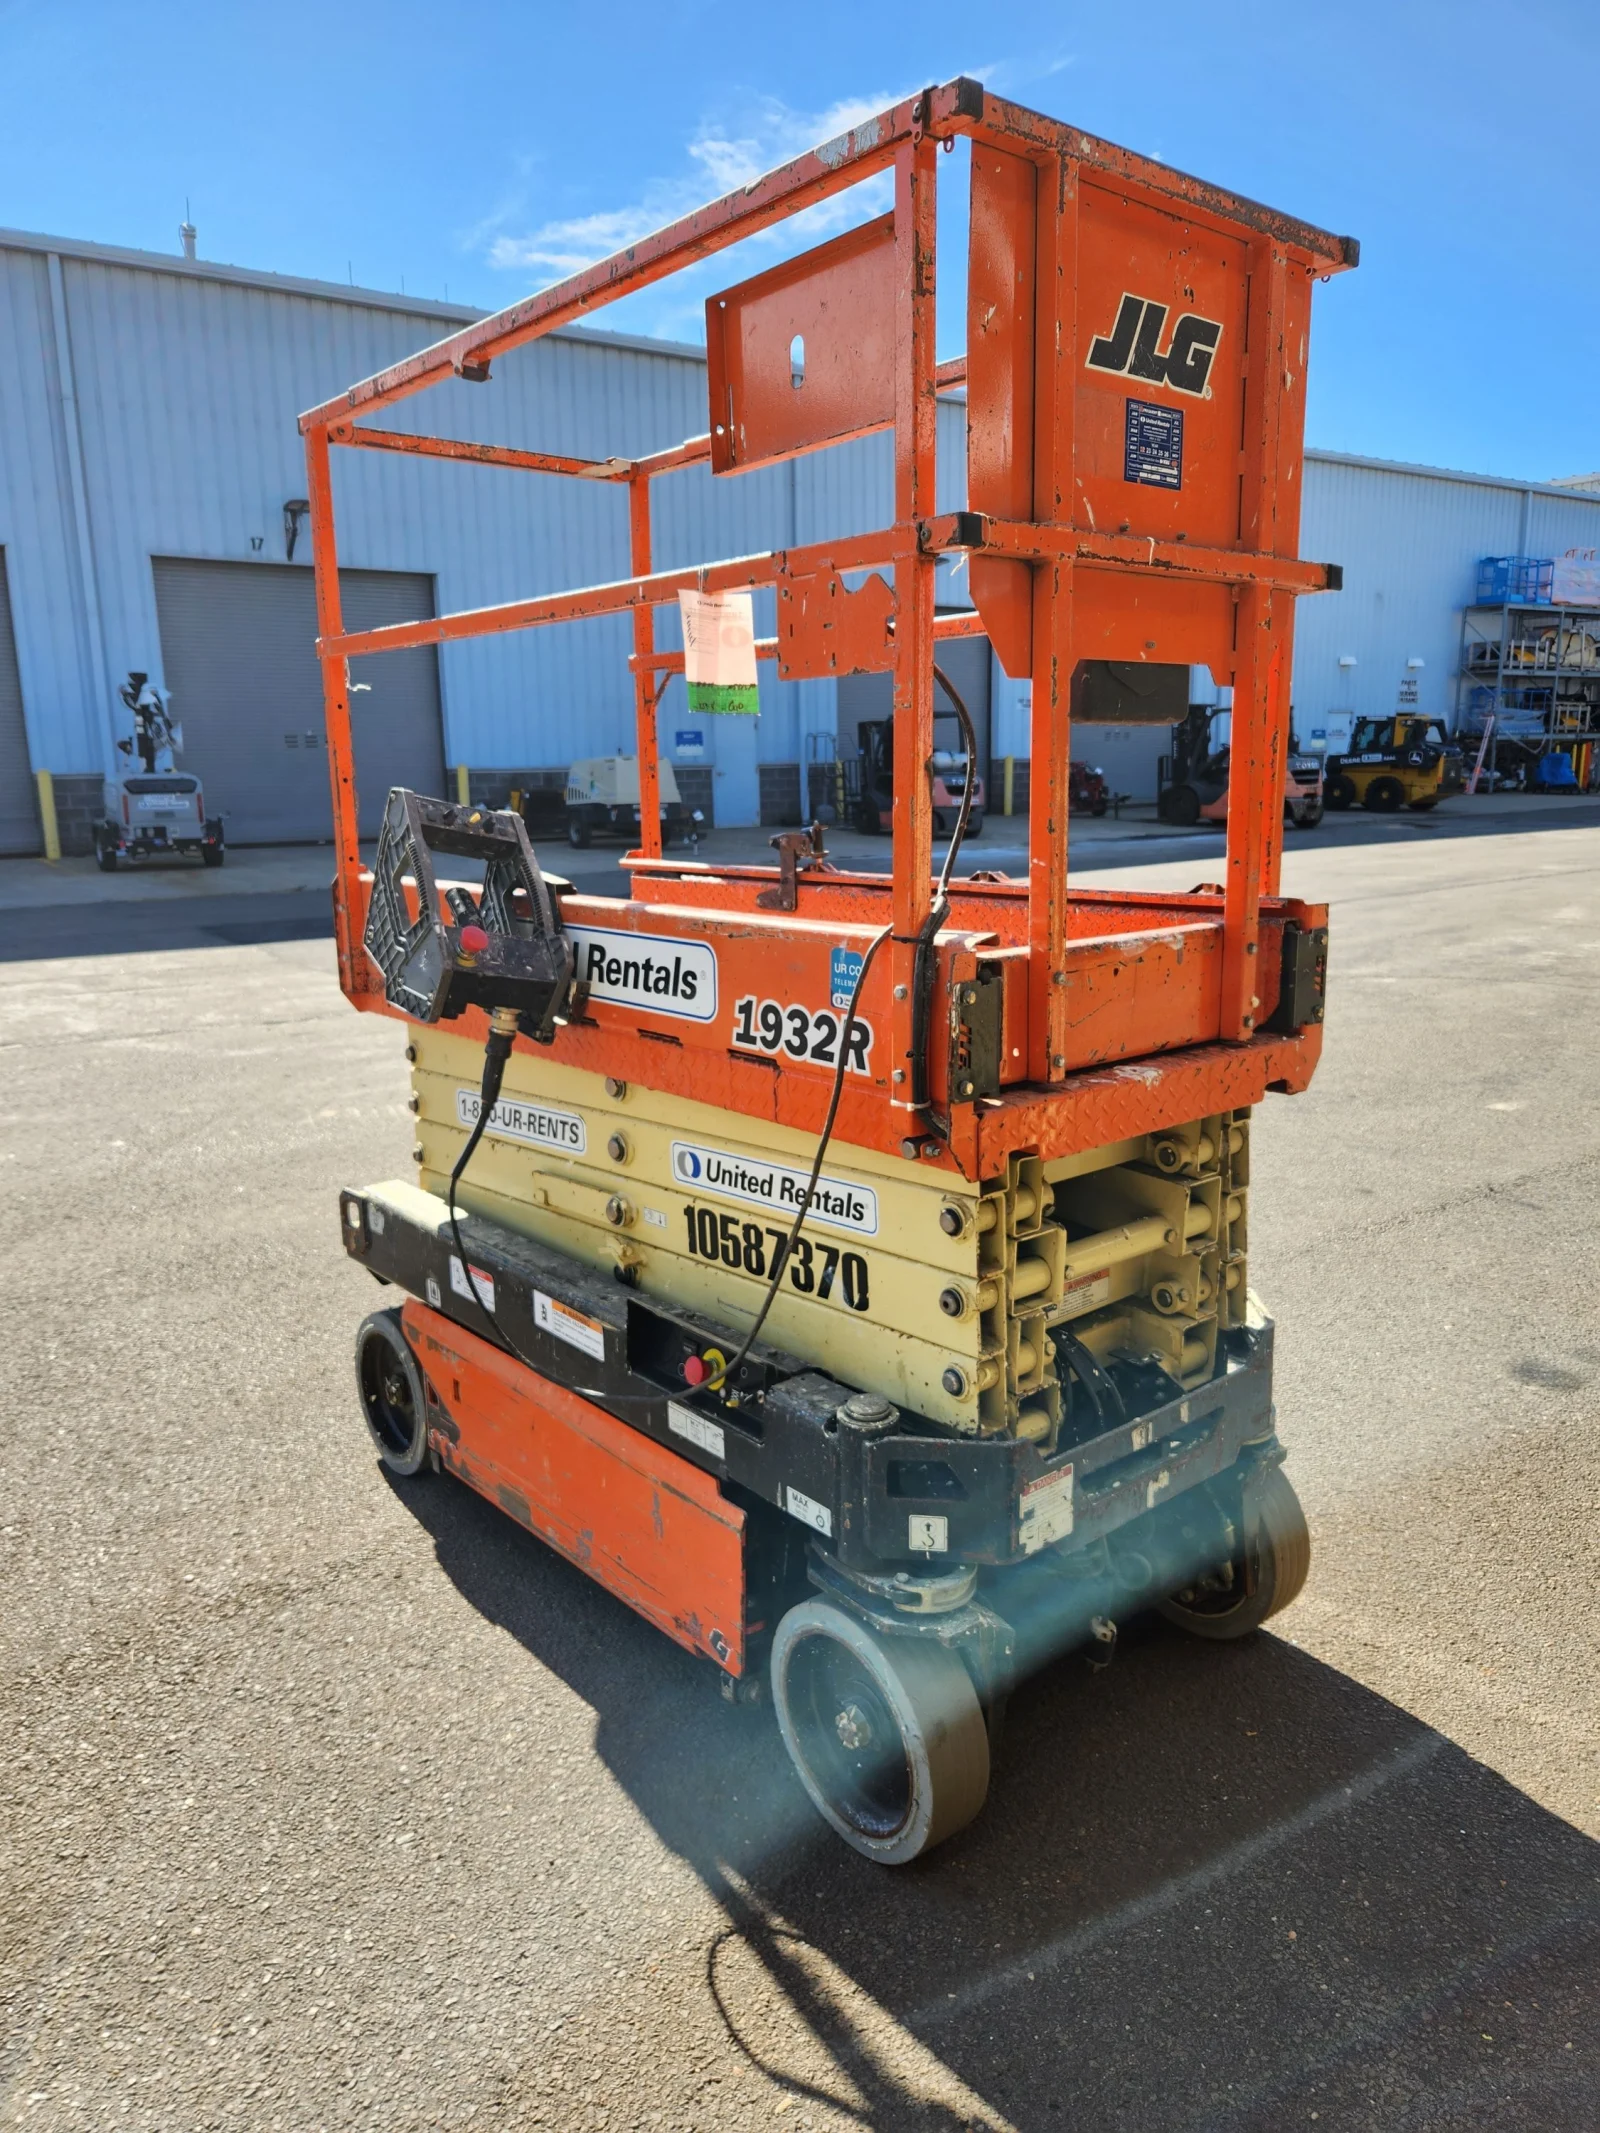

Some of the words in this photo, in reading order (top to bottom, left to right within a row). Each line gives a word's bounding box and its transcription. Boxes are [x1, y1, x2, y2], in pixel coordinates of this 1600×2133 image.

[1086, 293, 1222, 397] JLG
[250, 536, 264, 551] 17
[1340, 757, 1361, 765] DEERE
[586, 943, 698, 1000] Rentals
[834, 962, 847, 975] UR
[736, 999, 869, 1071] 1932R
[461, 1097, 580, 1144] 1-80-UR-RENTS
[706, 1158, 774, 1198] United
[780, 1176, 865, 1221] Rentals
[684, 1204, 870, 1312] 10587370
[792, 1491, 809, 1508] MAX
